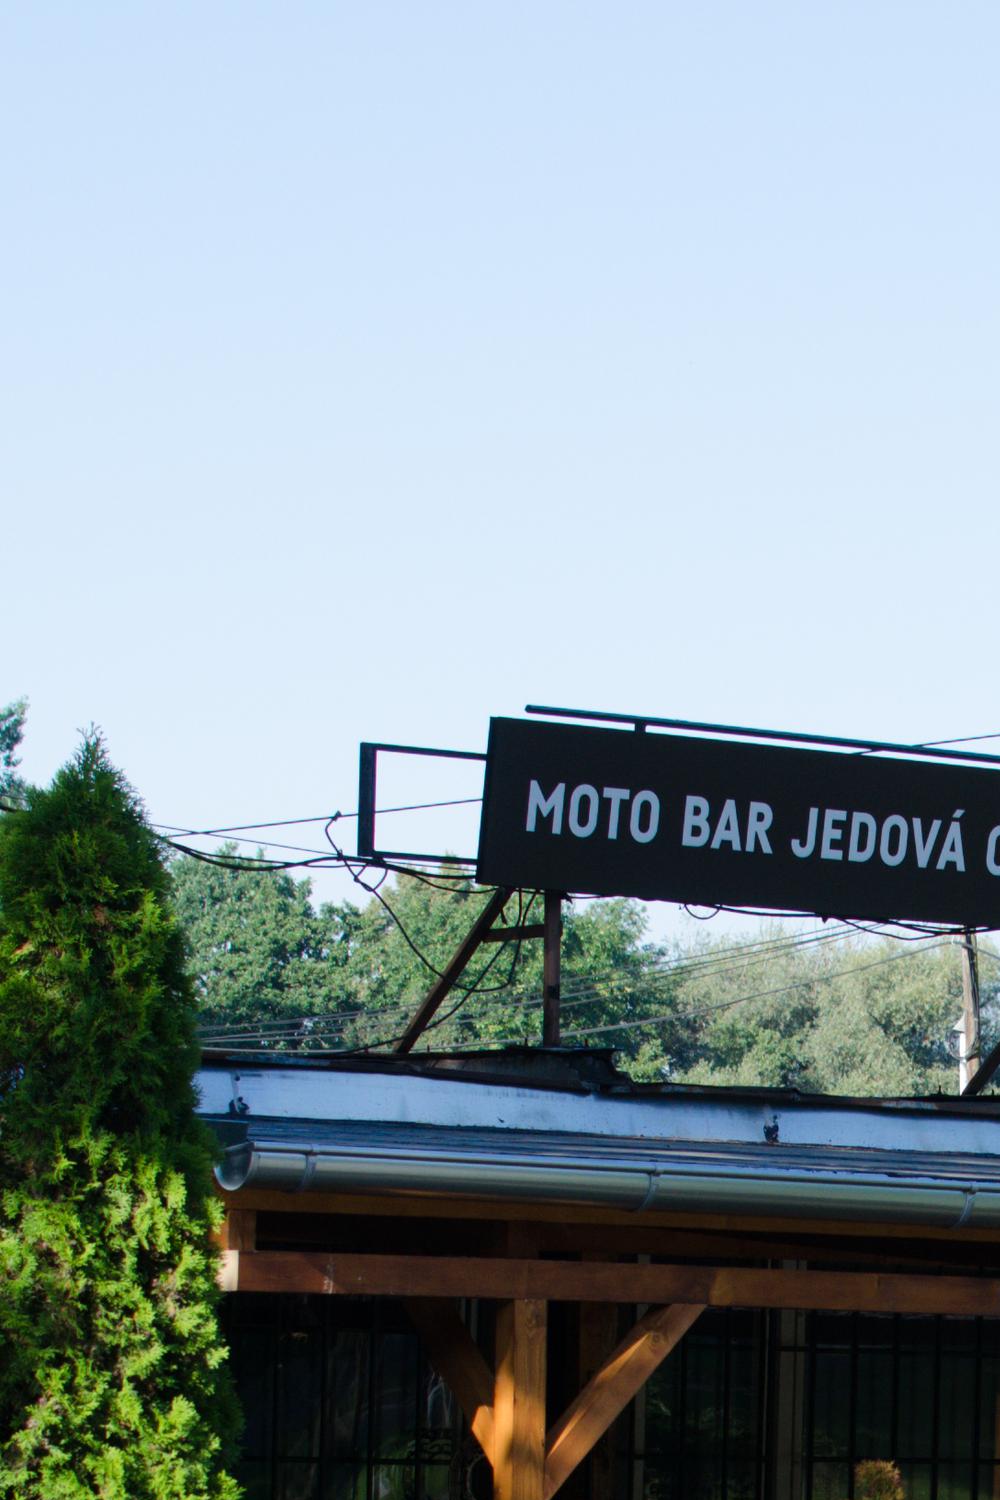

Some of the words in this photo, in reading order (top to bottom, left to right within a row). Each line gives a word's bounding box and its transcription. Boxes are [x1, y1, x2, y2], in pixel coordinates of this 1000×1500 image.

[526, 779, 660, 843] MOTO
[681, 795, 774, 854] BAR
[790, 807, 966, 872] JEDOVÁ
